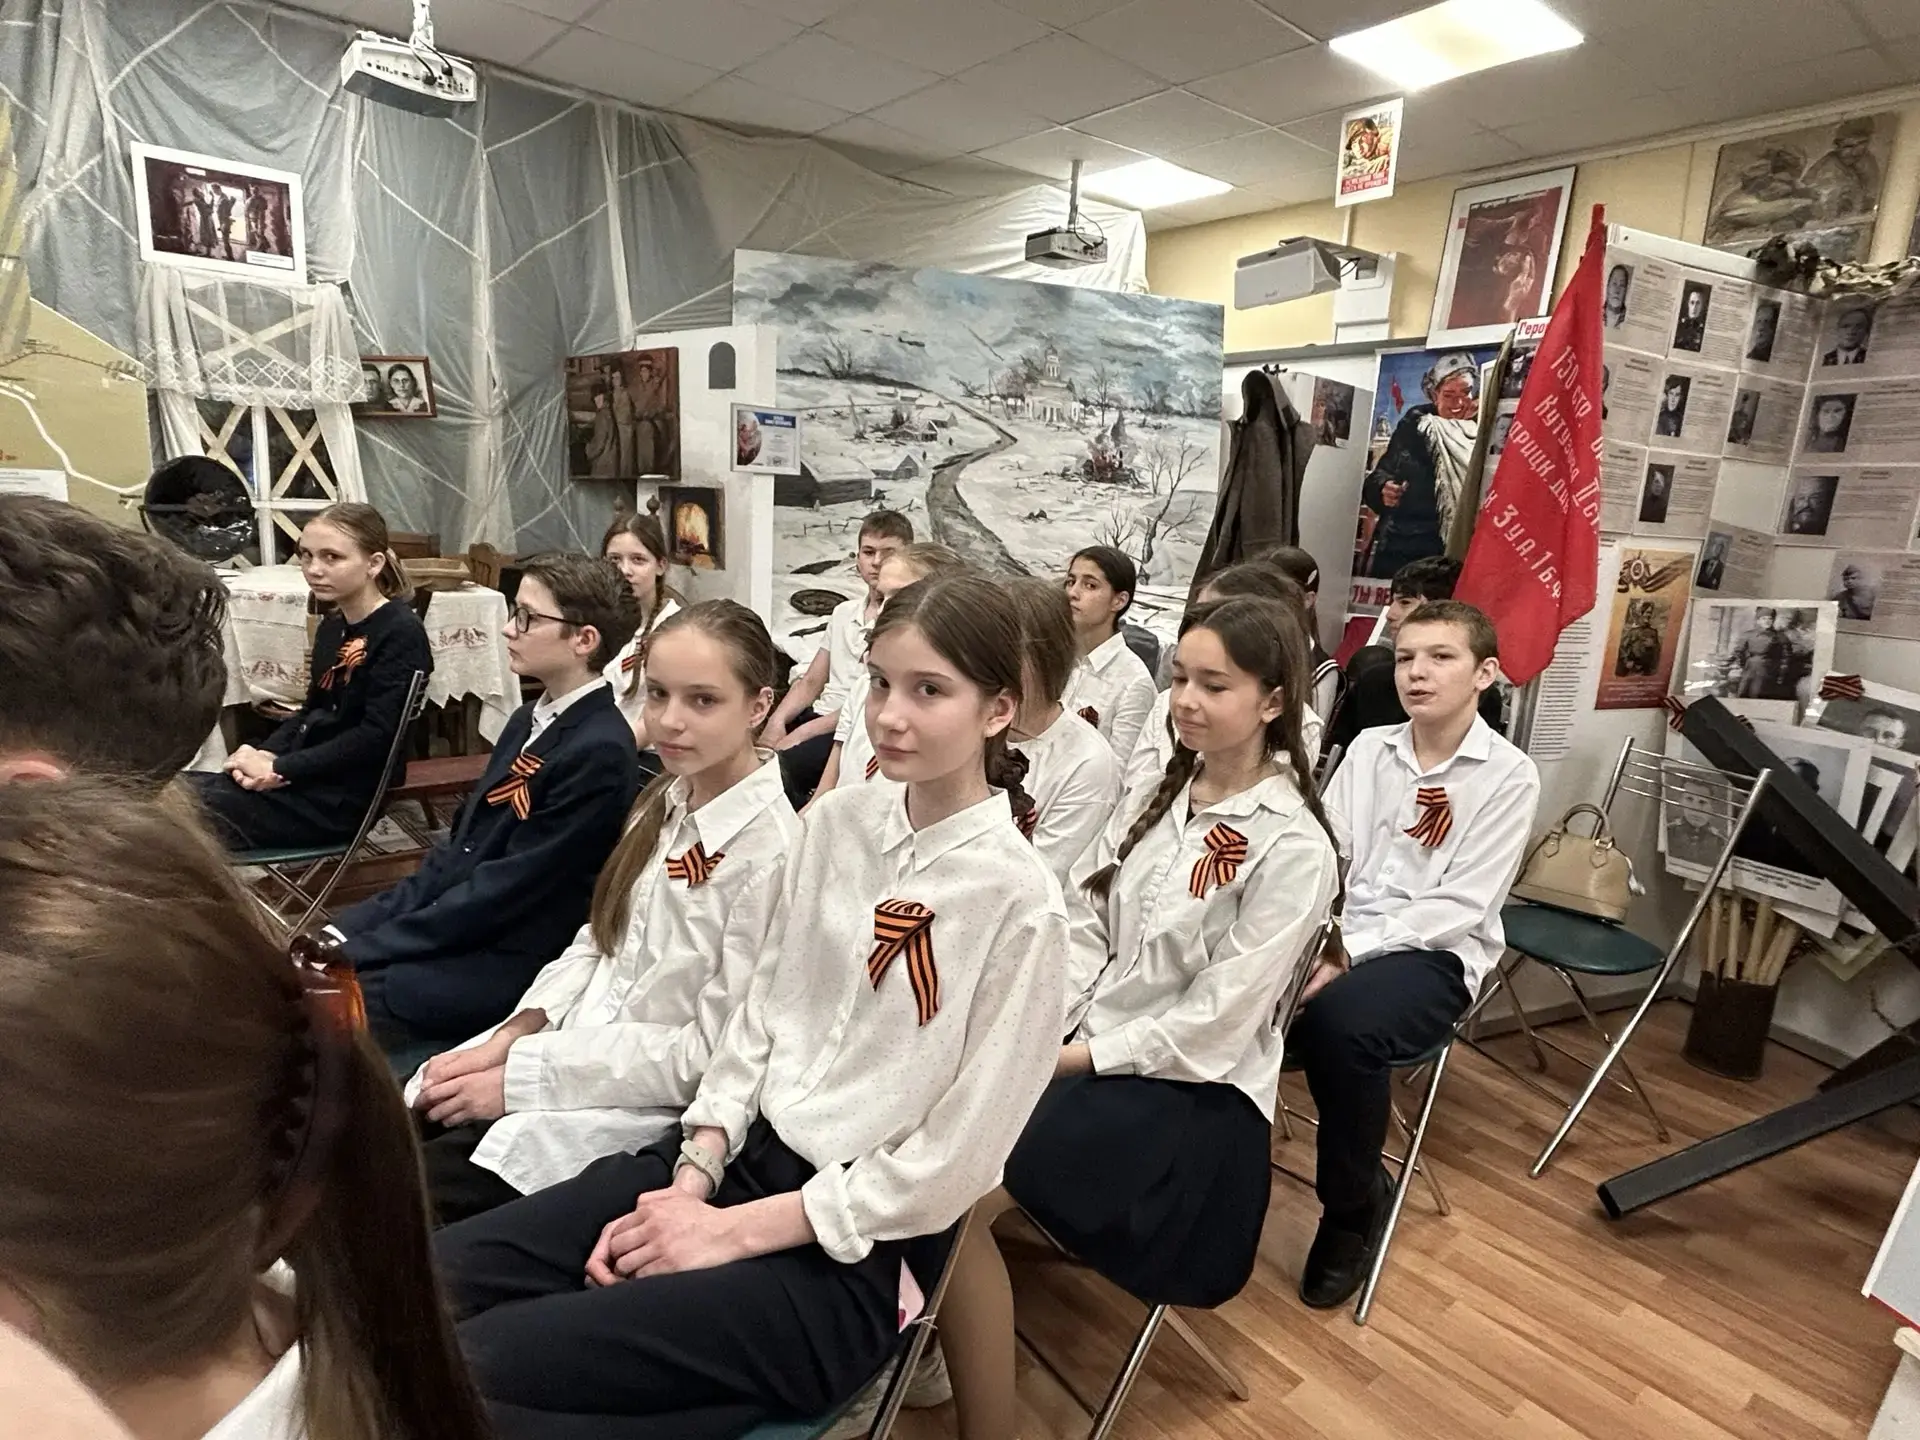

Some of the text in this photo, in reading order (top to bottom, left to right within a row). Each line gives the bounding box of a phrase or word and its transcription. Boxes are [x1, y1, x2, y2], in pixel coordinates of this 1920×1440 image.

[1517, 321, 1546, 338] Геро
[1550, 345, 1579, 389] 150
[1509, 420, 1556, 482] дрицк.
[1493, 503, 1519, 528] 3
[1352, 584, 1391, 605] ТЫ ВЕ
